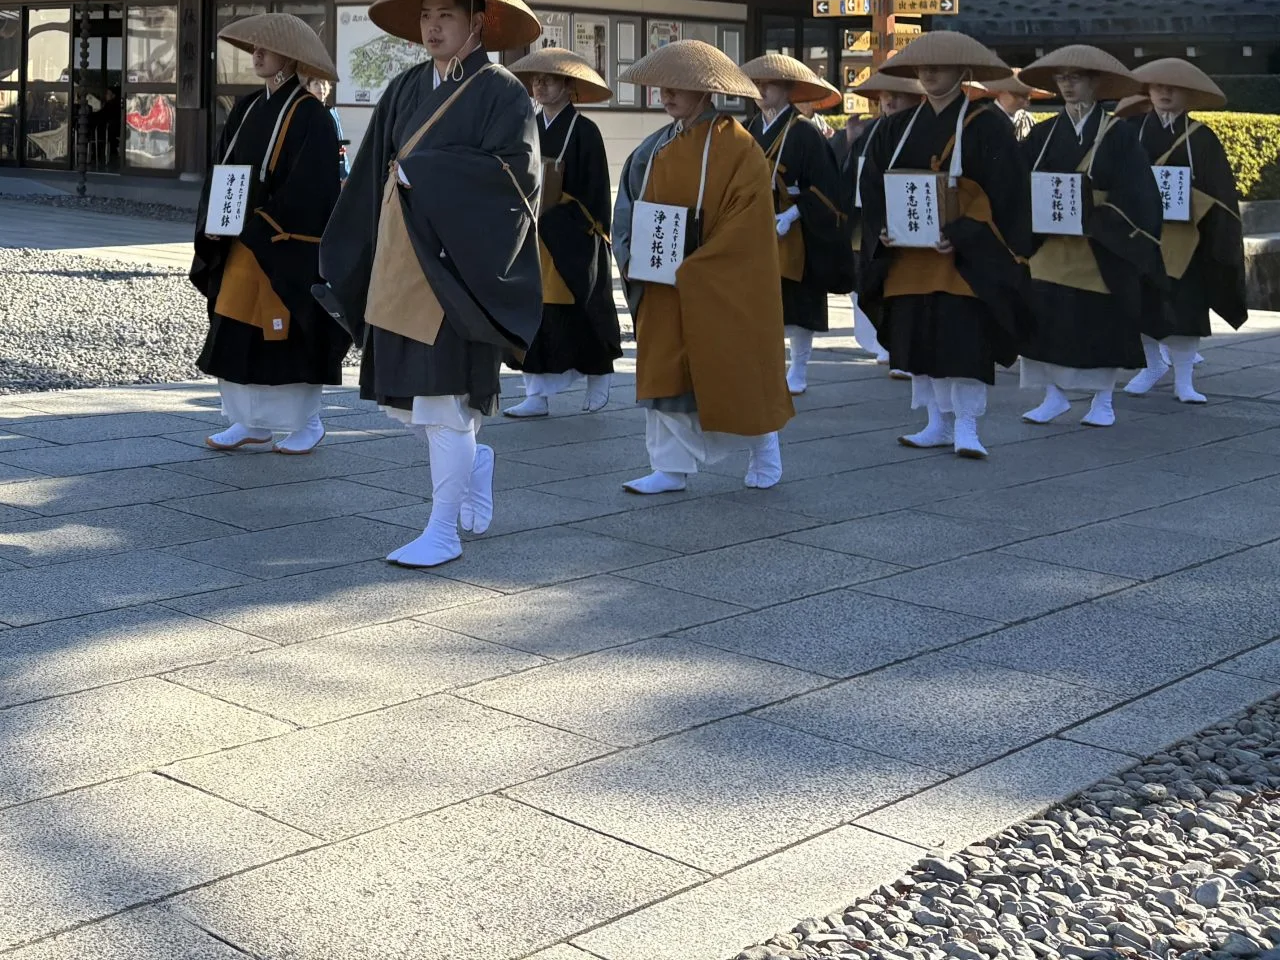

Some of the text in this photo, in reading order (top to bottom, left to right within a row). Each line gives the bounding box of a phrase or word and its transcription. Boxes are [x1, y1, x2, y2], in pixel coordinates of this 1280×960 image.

[221, 173, 236, 228] 浄志托鉢
[905, 182, 920, 233] 浄志托鉢
[650, 210, 667, 270] 浄志托鉢
[670, 212, 681, 263] 歳末たすけあい
